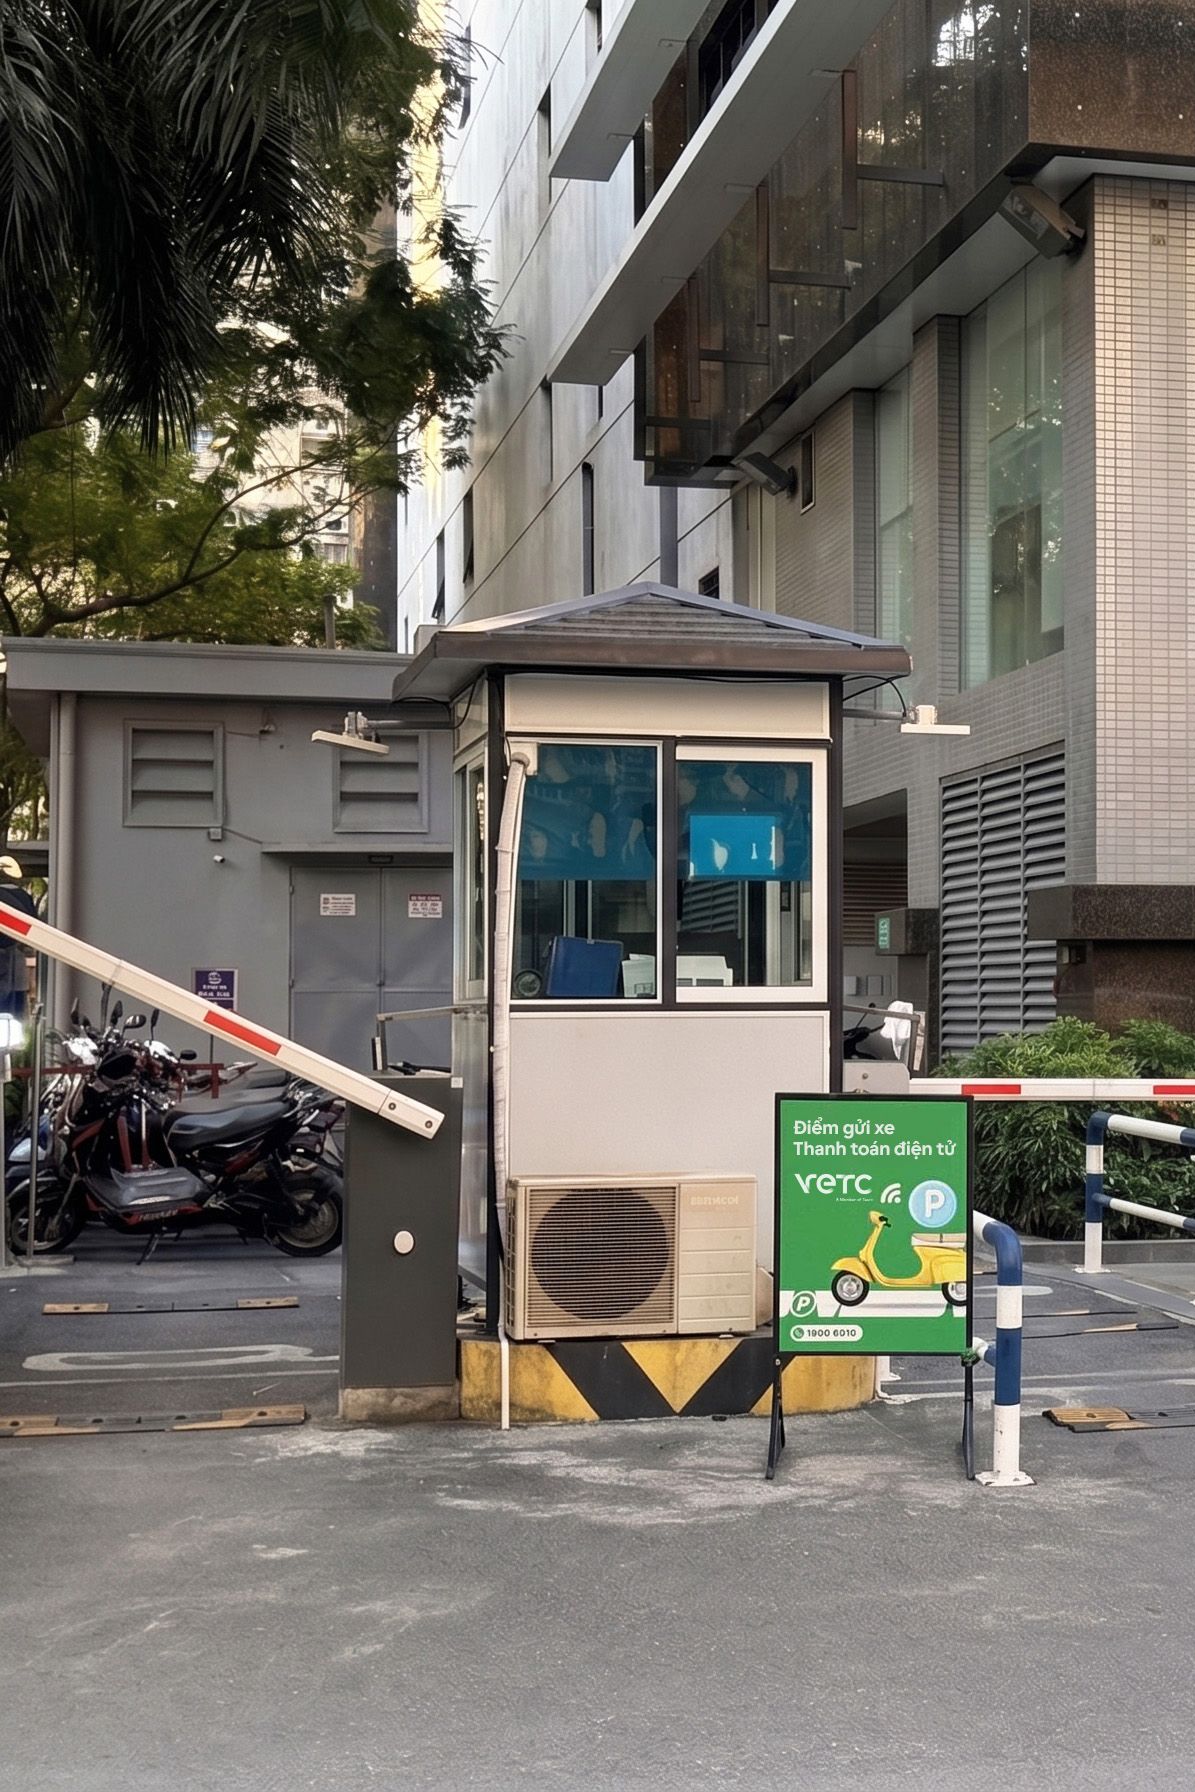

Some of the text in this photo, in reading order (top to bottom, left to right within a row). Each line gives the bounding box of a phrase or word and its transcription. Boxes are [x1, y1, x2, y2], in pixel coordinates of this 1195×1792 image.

[793, 1116, 896, 1139] Điểm gửi xe
[793, 1139, 957, 1160] Thanh toán điện tử
[924, 1189, 946, 1218] P
[796, 1296, 811, 1312] P
[807, 1329, 857, 1337] 1900 6010
